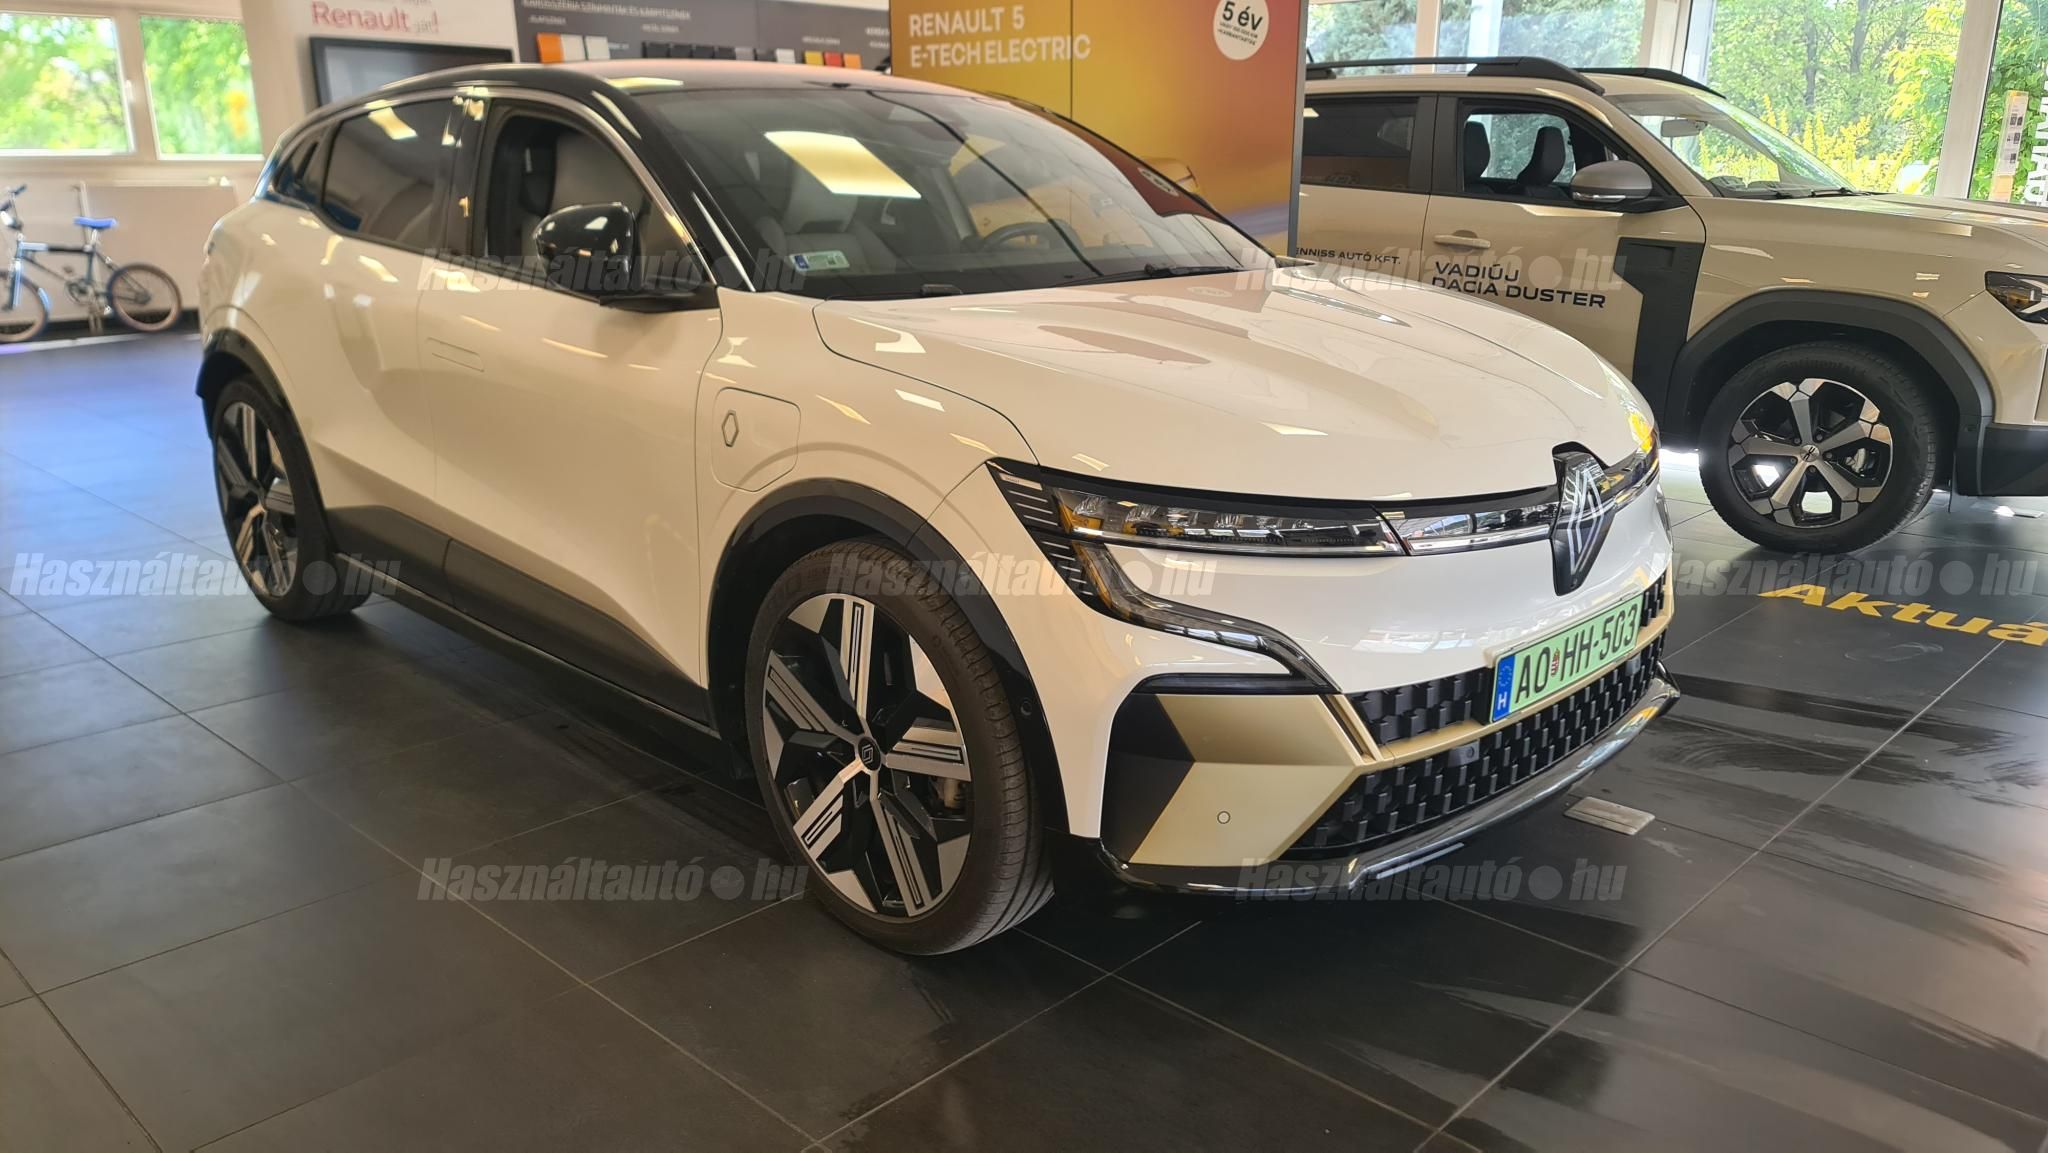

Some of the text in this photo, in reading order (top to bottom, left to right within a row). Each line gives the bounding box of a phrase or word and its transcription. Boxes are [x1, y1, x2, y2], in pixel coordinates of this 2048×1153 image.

[310, 0, 409, 32] Renault
[909, 5, 1025, 37] RENAULT 5
[1222, 1, 1236, 21] 5
[1237, 6, 1263, 31] év
[910, 34, 1091, 68] E-TECH ELECTRIC
[1339, 251, 1372, 262] AUTÓ
[1435, 261, 1519, 282] VADIÚJ
[1431, 277, 1606, 308] DACIA DUSTER
[1560, 603, 1638, 682] HH-503
[1497, 691, 1508, 711] H
